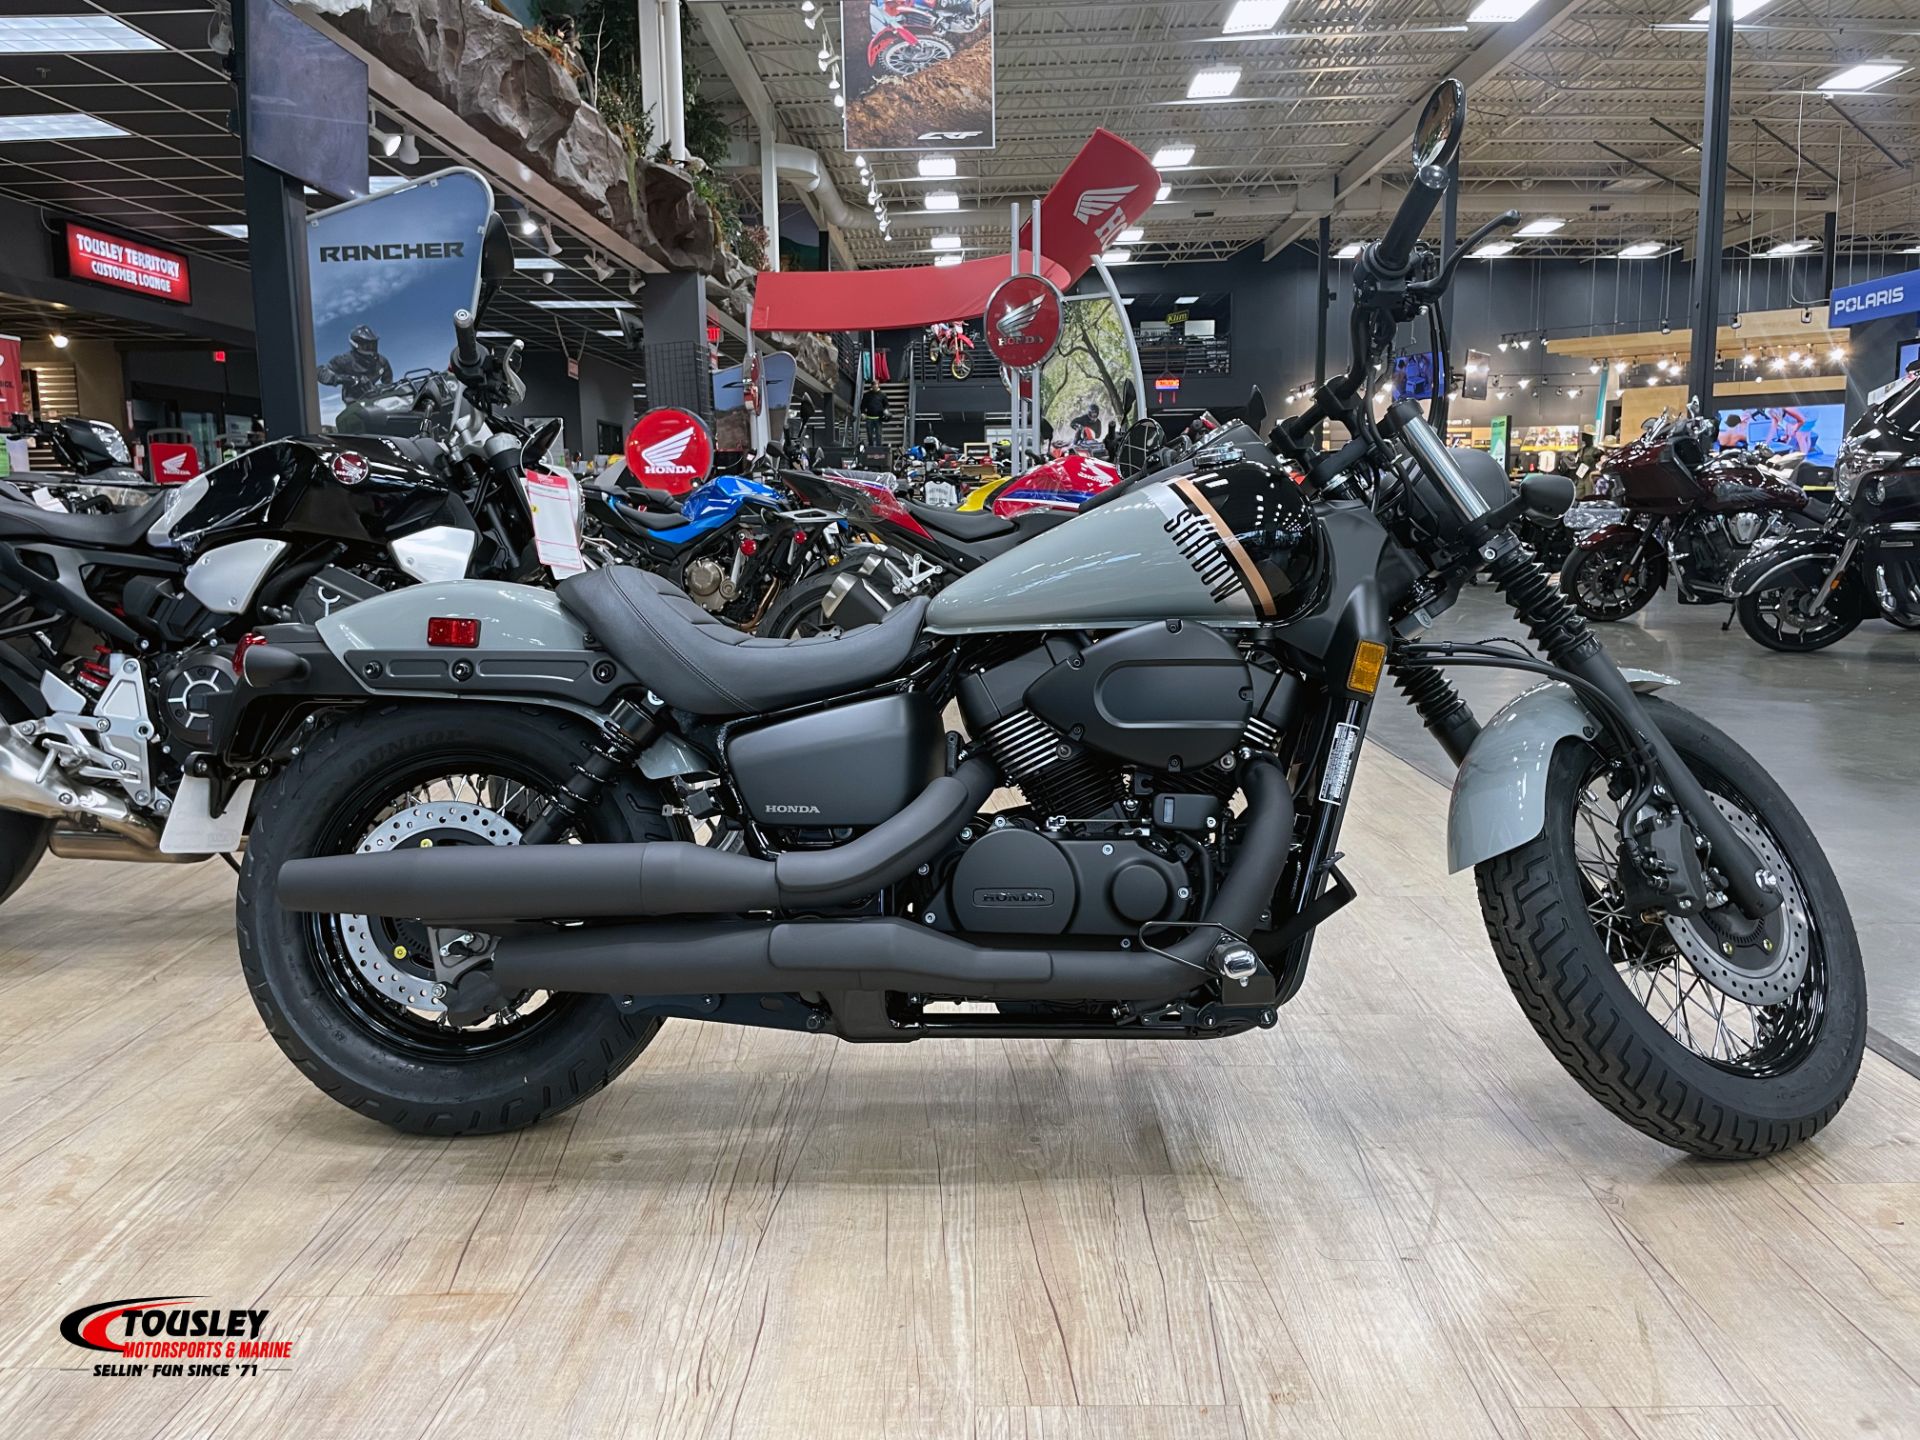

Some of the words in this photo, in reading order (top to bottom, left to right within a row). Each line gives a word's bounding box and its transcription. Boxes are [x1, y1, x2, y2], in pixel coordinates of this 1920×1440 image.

[76, 233, 123, 262] TOUSLEY
[125, 247, 179, 278] TERRITORY
[319, 242, 465, 263] RANCHER
[91, 261, 137, 285] CUSTOMER
[138, 272, 171, 293] LOUNGE
[1834, 286, 1904, 315] POLARIS
[645, 465, 697, 474] HONDA
[1163, 509, 1245, 604] SHADOW
[765, 805, 820, 813] HONDA
[983, 892, 1046, 902] HONDA
